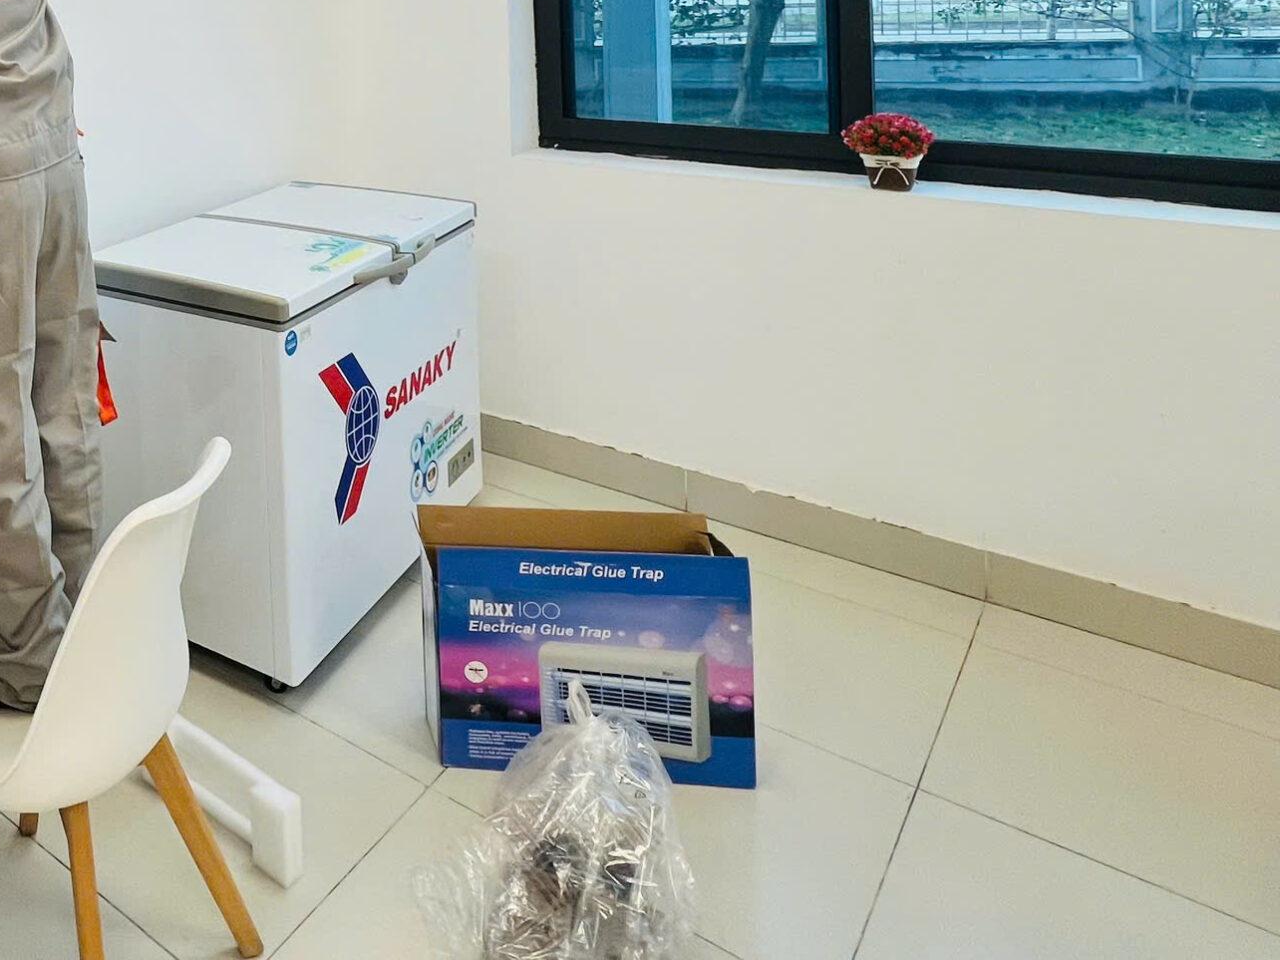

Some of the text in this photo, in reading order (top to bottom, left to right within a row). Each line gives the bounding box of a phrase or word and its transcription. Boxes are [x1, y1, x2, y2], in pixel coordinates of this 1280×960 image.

[384, 340, 456, 419] SANAKY
[519, 561, 664, 582] Electrical Glue Trap
[469, 599, 560, 620] Maxx 100
[468, 620, 611, 640] Electrical Glue Trap
